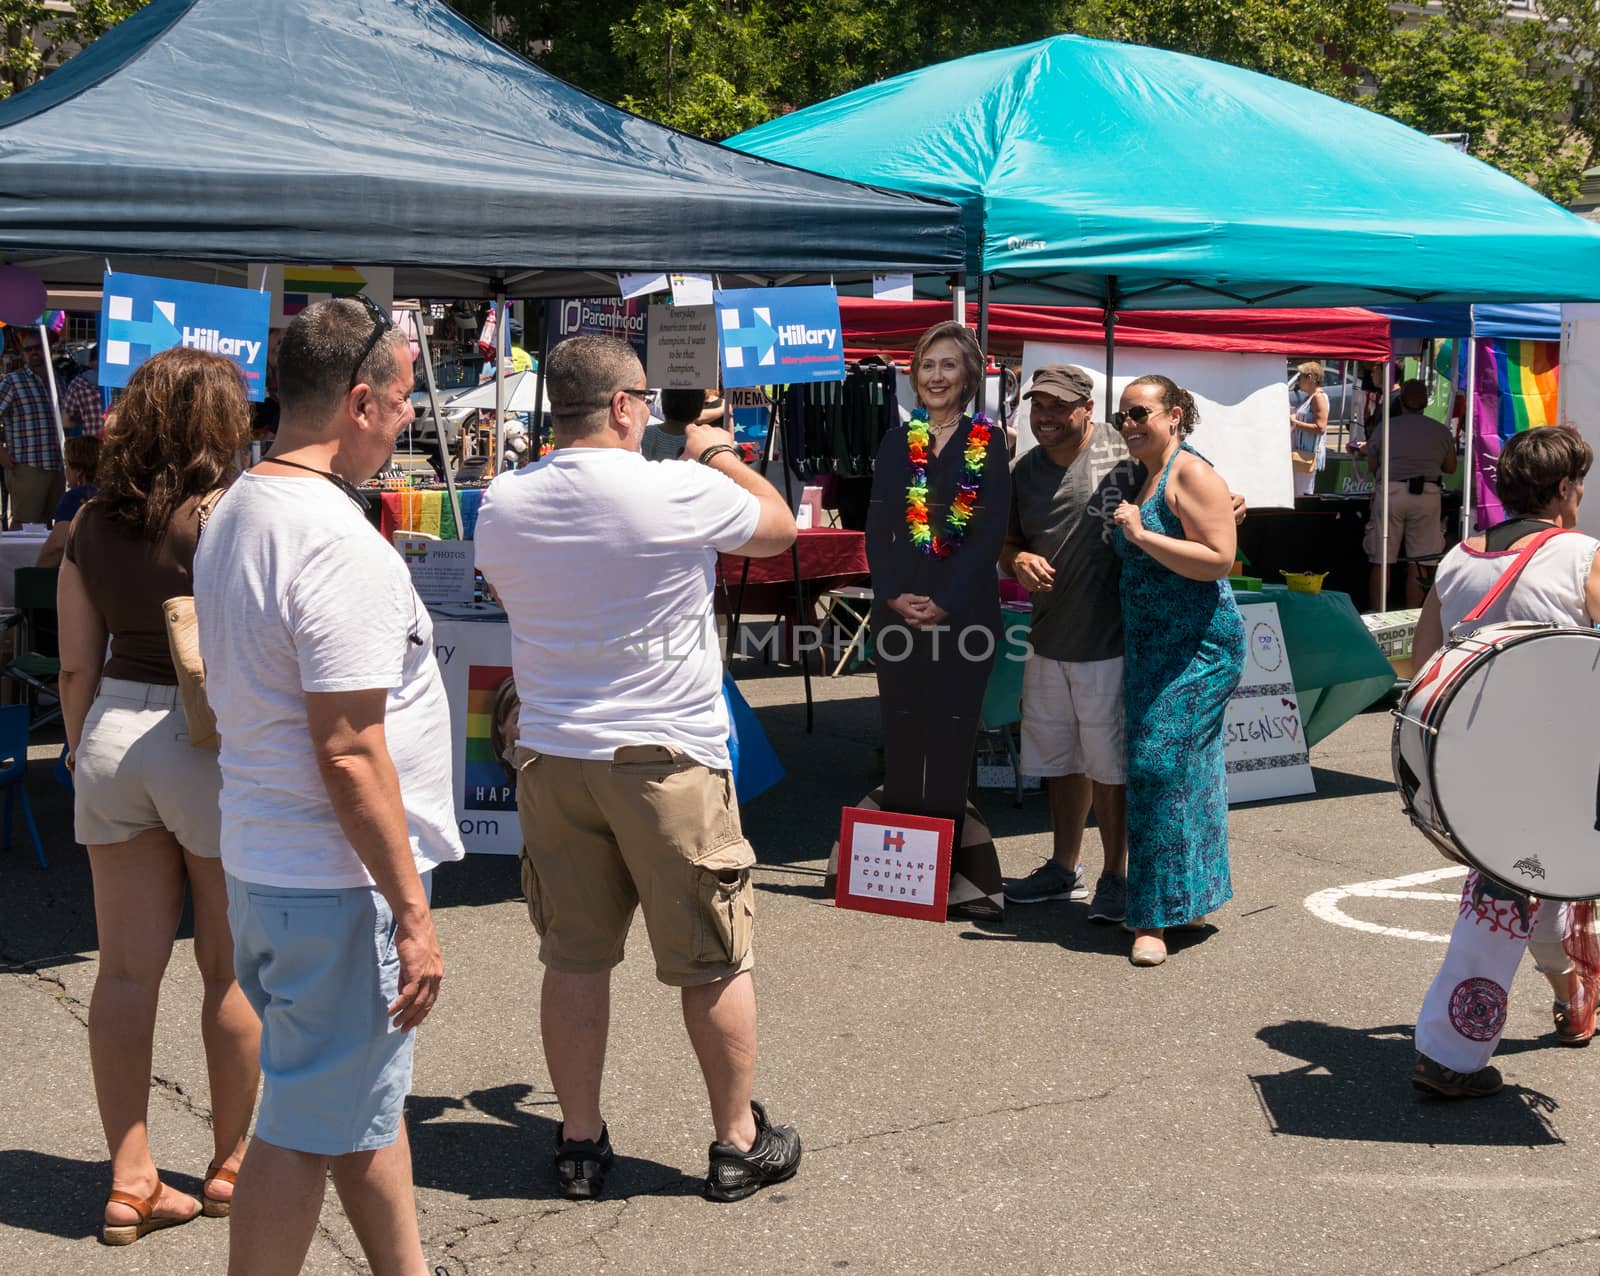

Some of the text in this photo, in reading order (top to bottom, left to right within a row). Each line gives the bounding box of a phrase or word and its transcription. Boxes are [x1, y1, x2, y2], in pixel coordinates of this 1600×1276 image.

[582, 307, 644, 330] Parenthood
[778, 324, 837, 350] Hillary
[182, 326, 262, 364] Hillary
[432, 550, 466, 560] PHOTOS
[1376, 628, 1406, 642] TOLDO
[853, 854, 935, 871] ROCKLAND
[863, 868, 924, 882] COUNTY
[866, 882, 918, 896] PRIDE
